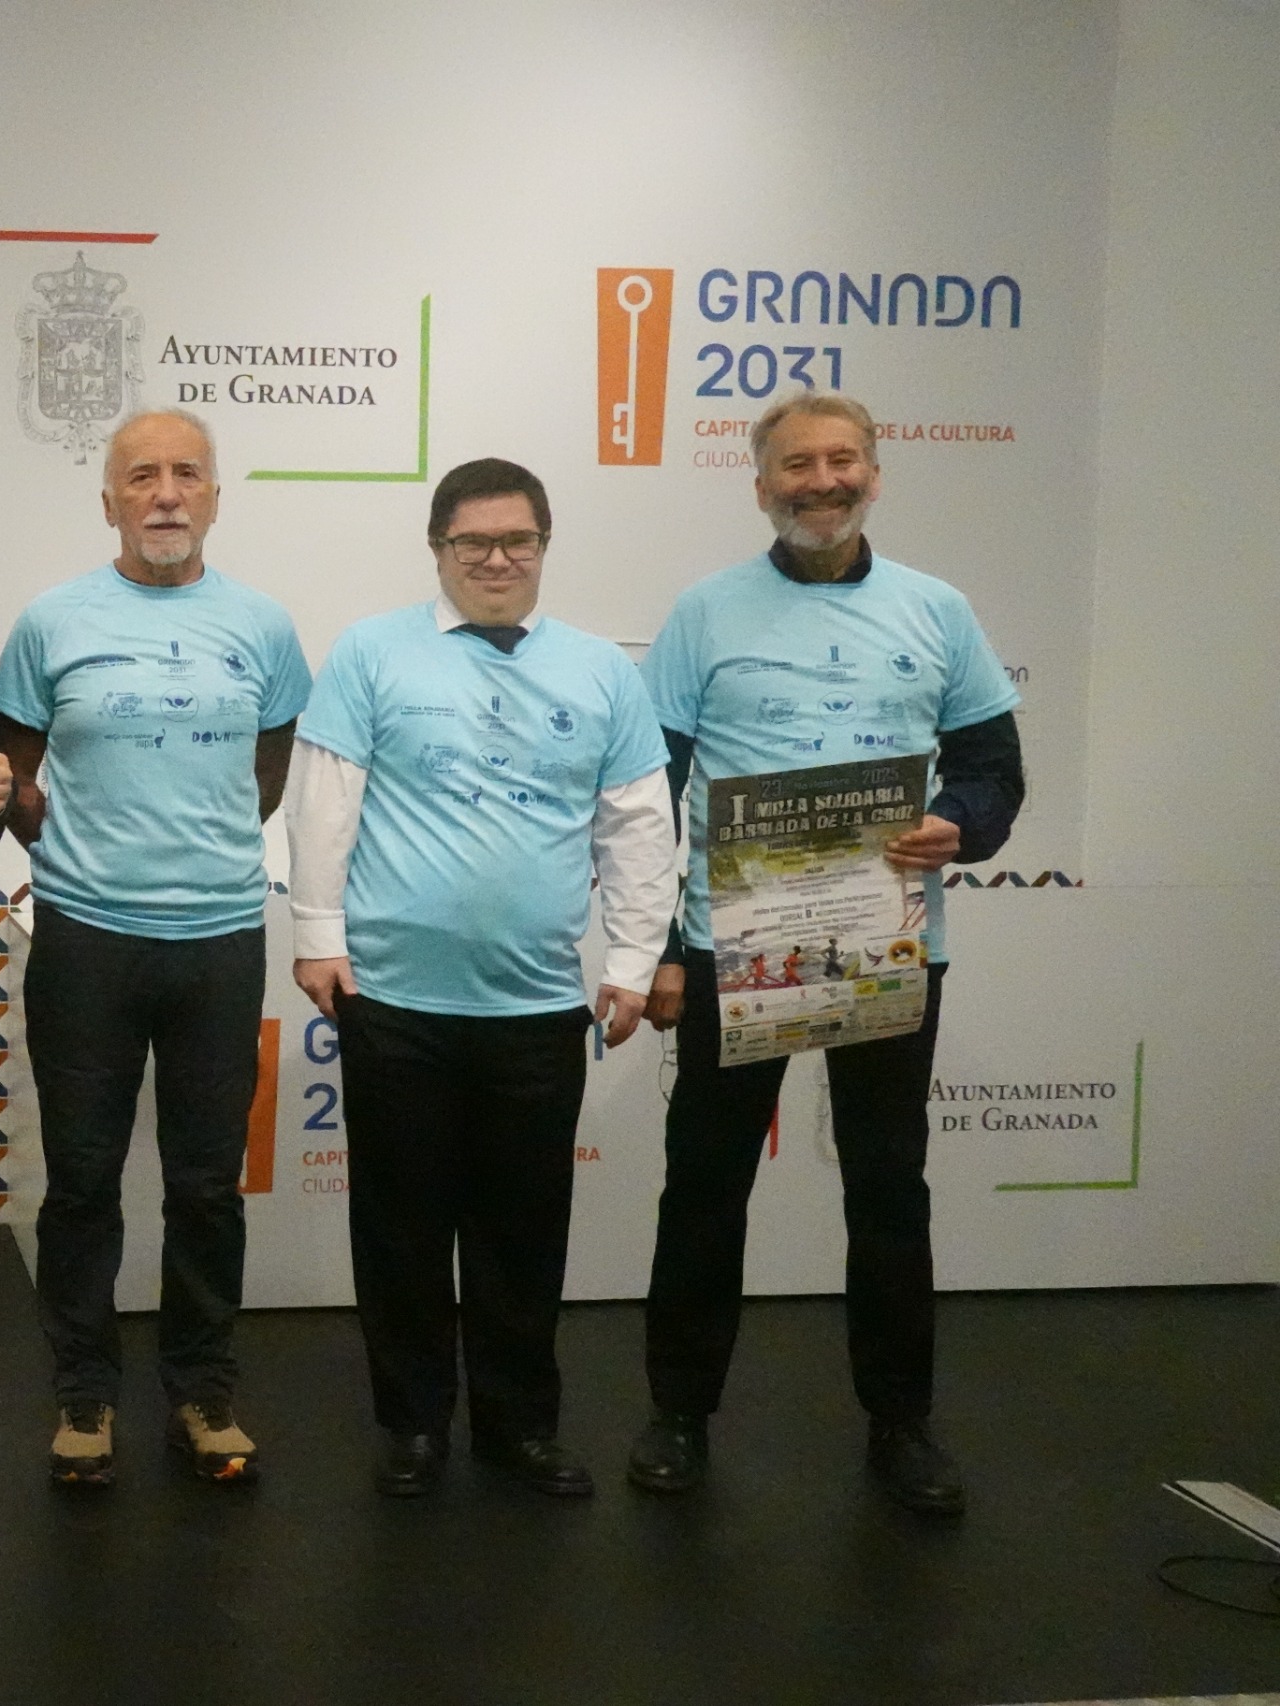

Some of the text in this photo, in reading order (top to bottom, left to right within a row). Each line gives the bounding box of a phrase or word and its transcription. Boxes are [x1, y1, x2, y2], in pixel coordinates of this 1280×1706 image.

[699, 268, 1021, 328] GRANADA
[158, 335, 397, 367] AYUNTAMIENTO
[696, 343, 842, 398] 2031
[178, 375, 376, 405] DE GRANADA
[694, 420, 750, 437] CAPIT
[902, 424, 925, 440] LA
[929, 425, 1015, 442] CULTURA
[693, 450, 752, 468] CIUDA
[192, 731, 231, 744] DOWN
[730, 794, 749, 825] I
[814, 786, 905, 811] SOLIDARIA
[719, 818, 810, 842] BARRIADA
[816, 814, 838, 830] DE
[842, 811, 864, 827] LA
[871, 803, 915, 823] CRUZ
[928, 1079, 1116, 1101] AYUNTAMIENTO
[941, 1107, 1098, 1132] DE GRANADA
